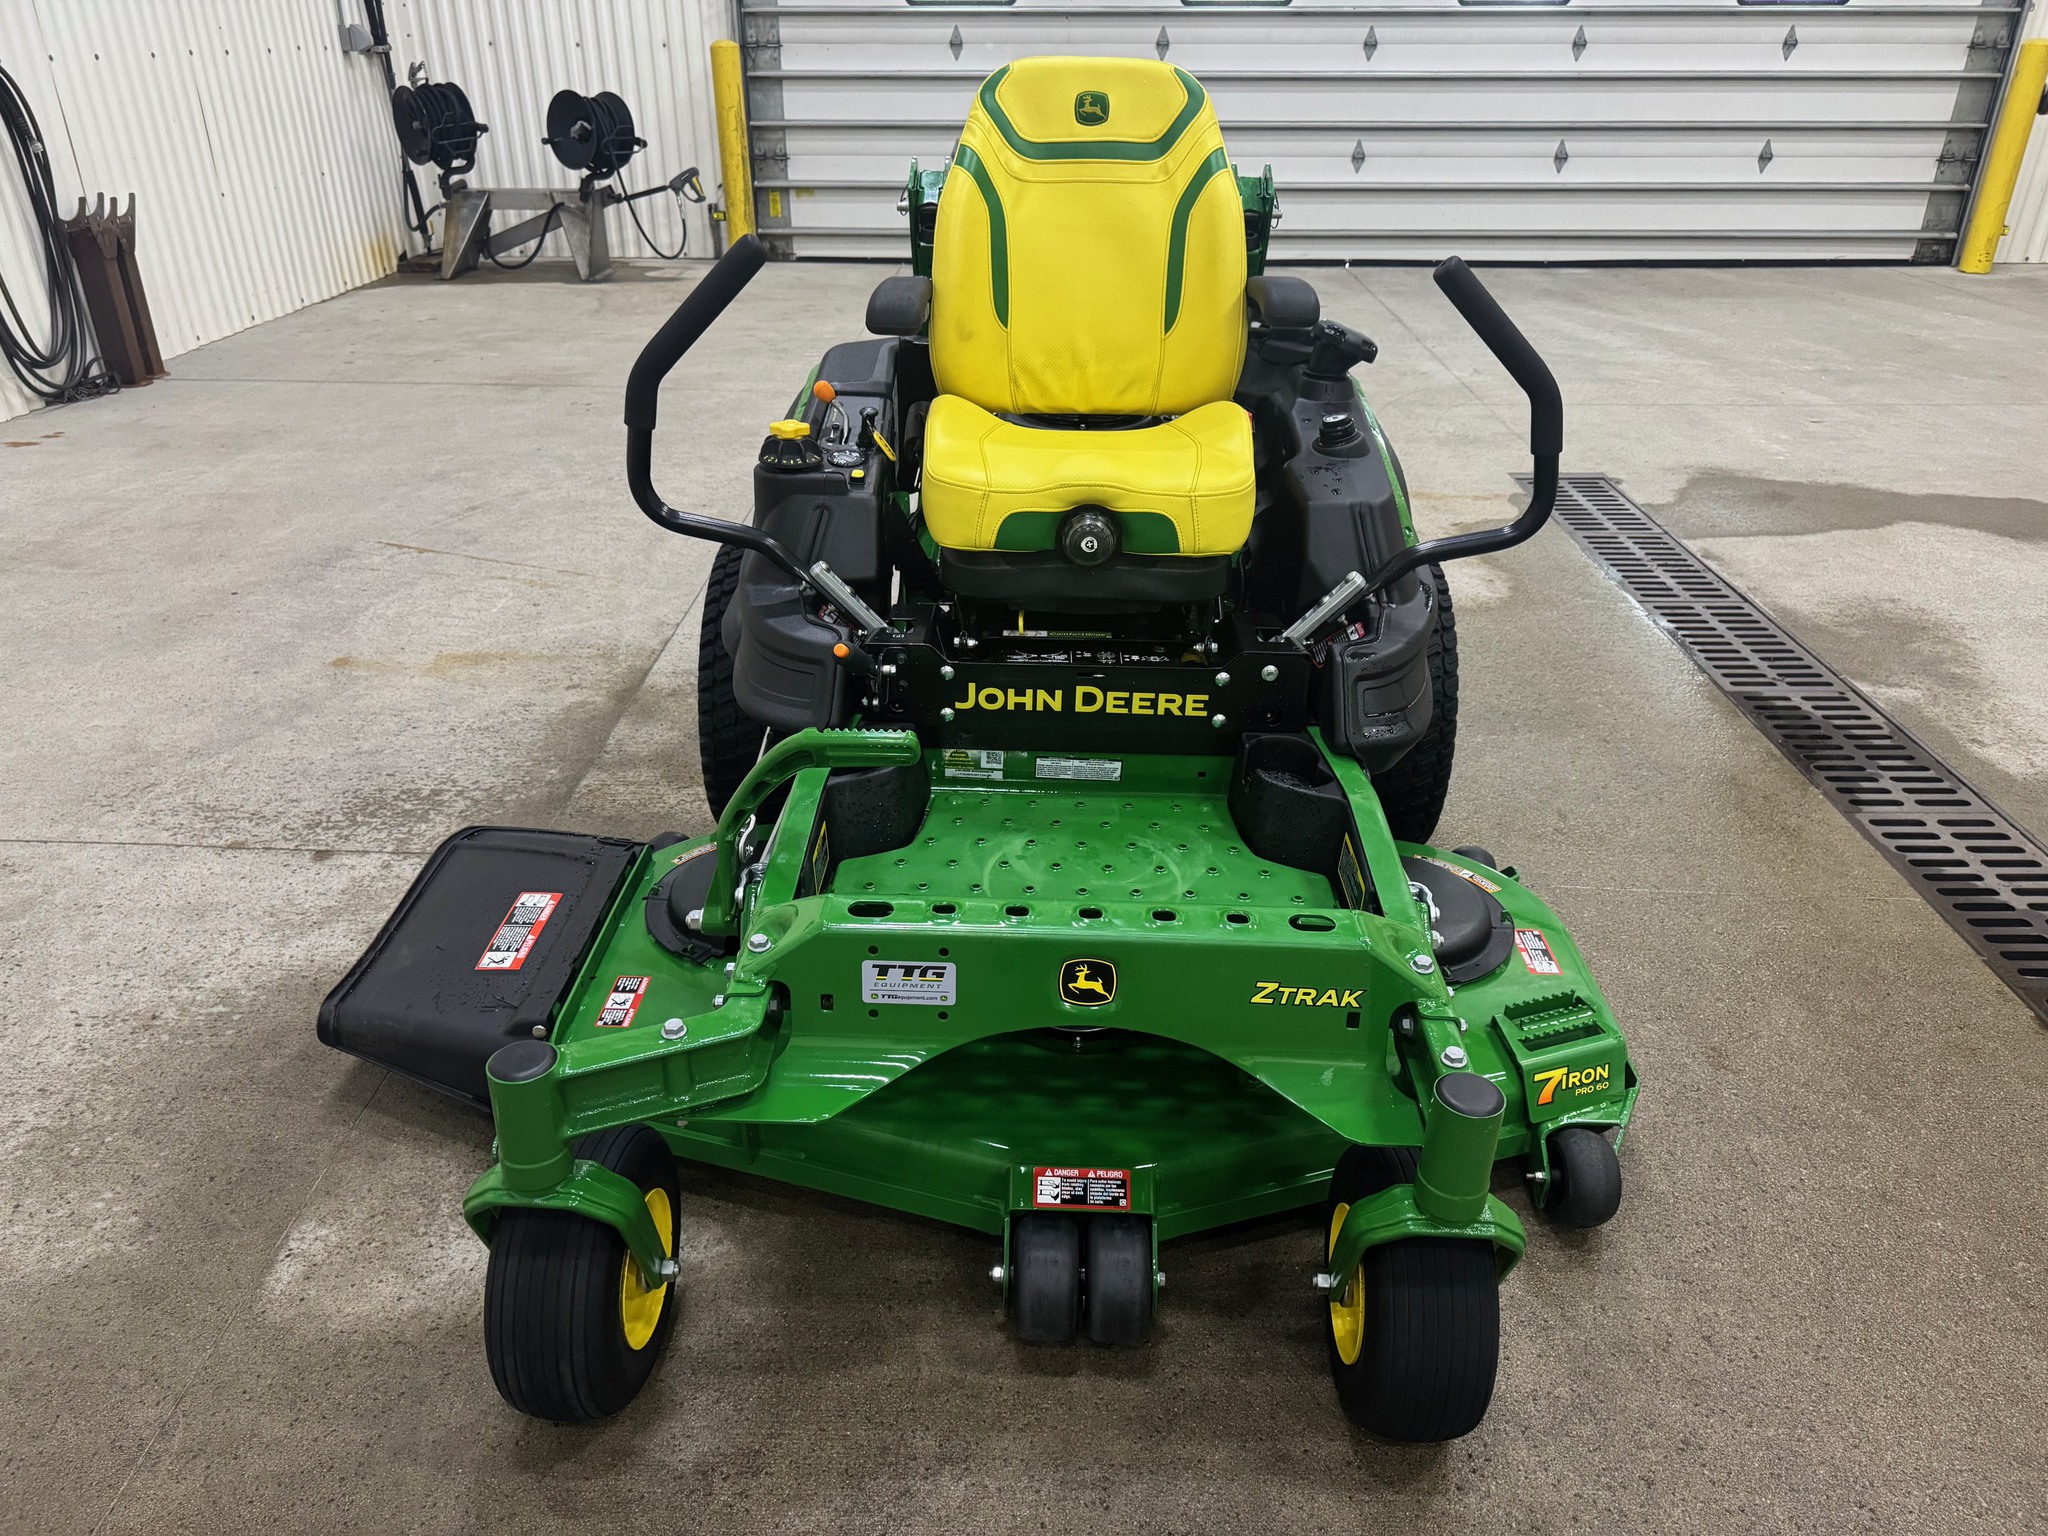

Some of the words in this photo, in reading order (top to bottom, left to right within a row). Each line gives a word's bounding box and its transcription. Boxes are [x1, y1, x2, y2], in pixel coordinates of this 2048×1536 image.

[954, 682, 1063, 712] JOHN
[1075, 685, 1209, 717] DEERE
[872, 964, 947, 982] TTG
[881, 993, 938, 1001] TTGequipment.com
[1250, 980, 1365, 1008] ZTRAK
[1575, 1085, 1594, 1096] PRO
[1596, 1081, 1609, 1091] 60
[1053, 1168, 1079, 1177] DANGER
[1096, 1170, 1123, 1178] PELIGRO
